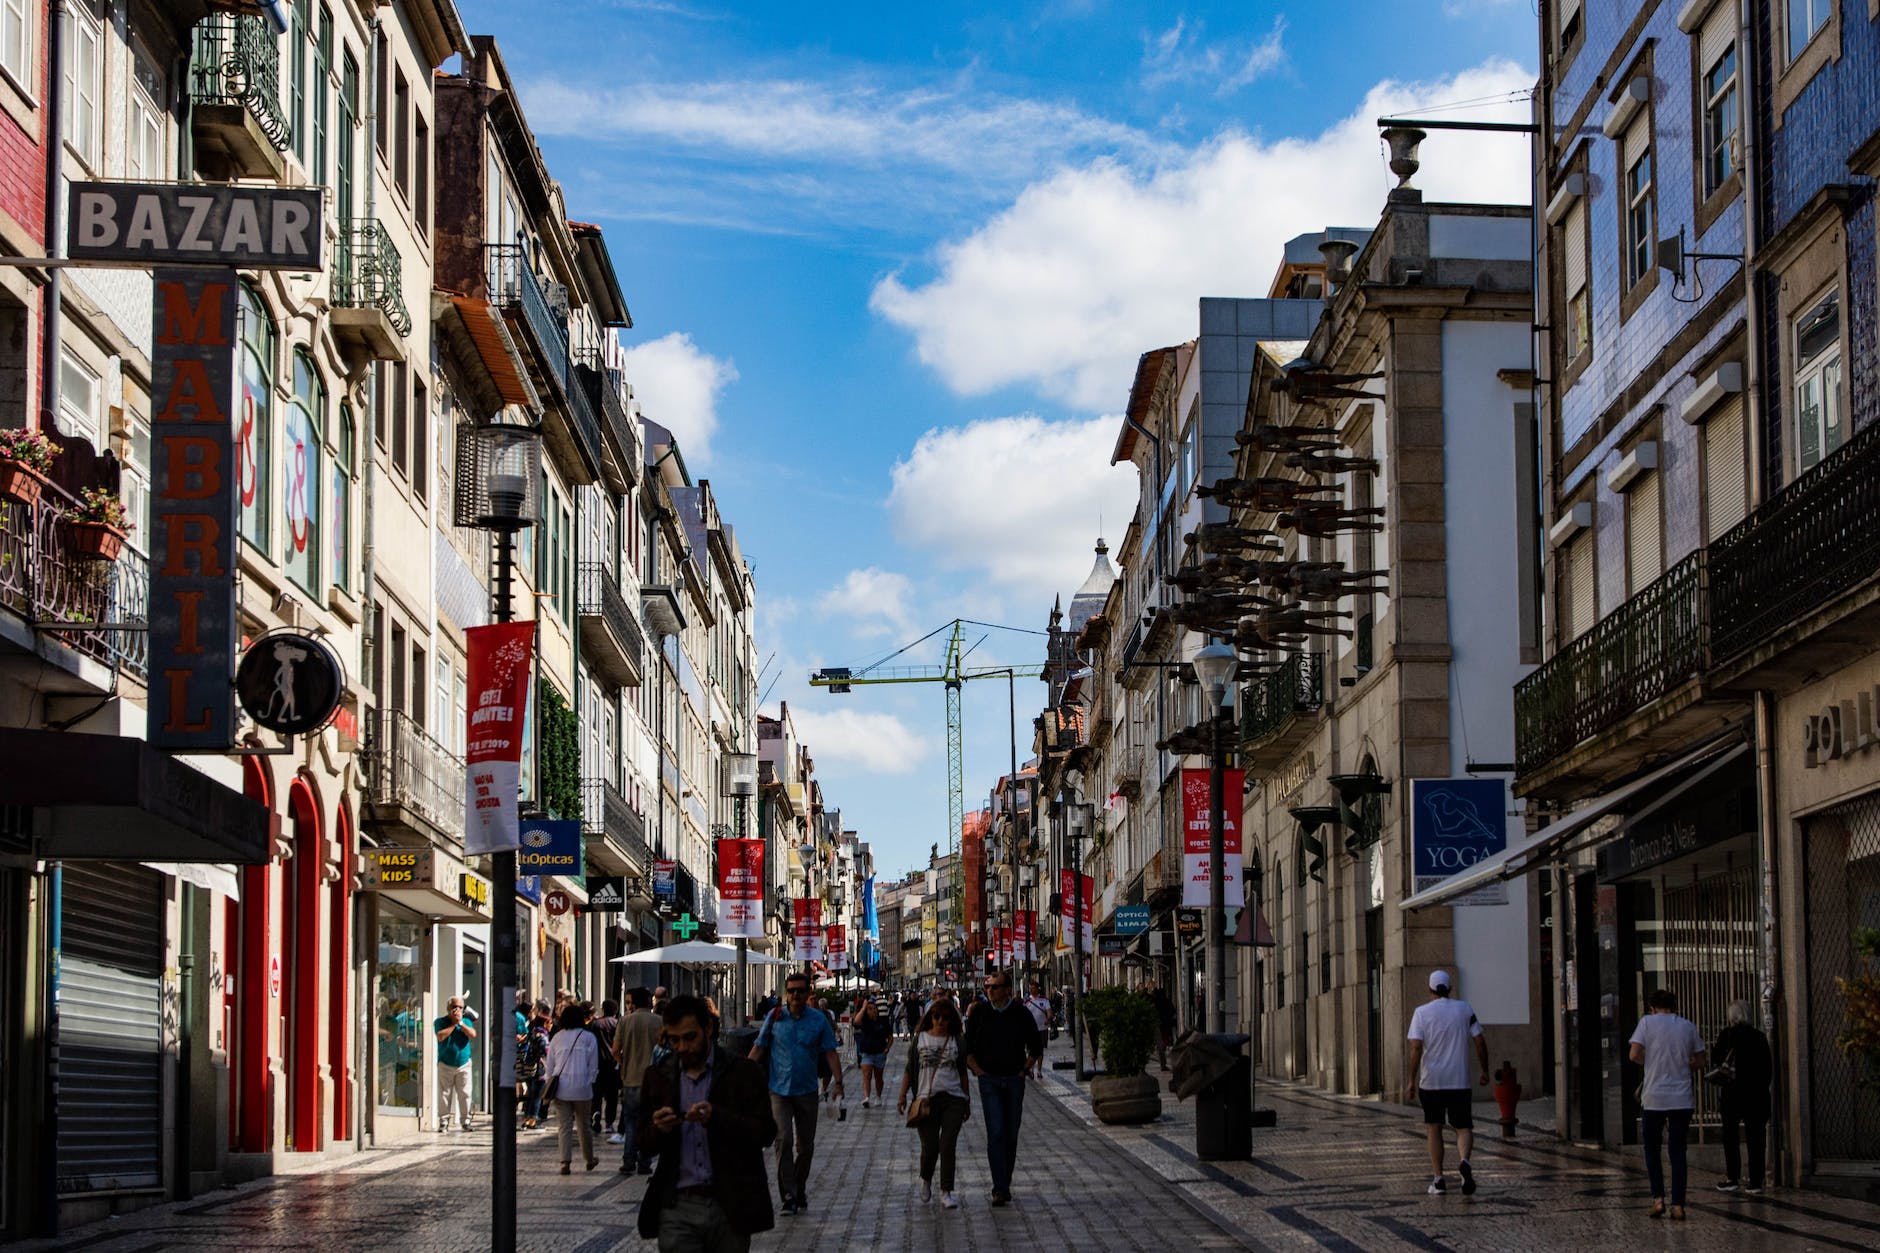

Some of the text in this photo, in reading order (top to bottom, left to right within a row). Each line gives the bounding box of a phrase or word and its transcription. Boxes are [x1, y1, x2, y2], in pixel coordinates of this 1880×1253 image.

[77, 192, 310, 256] BAZAR
[158, 282, 229, 733] MABRIL
[379, 854, 416, 866] MASS
[1425, 846, 1493, 868] YOGA
[381, 870, 412, 882] KIDS
[590, 895, 623, 904] adidas
